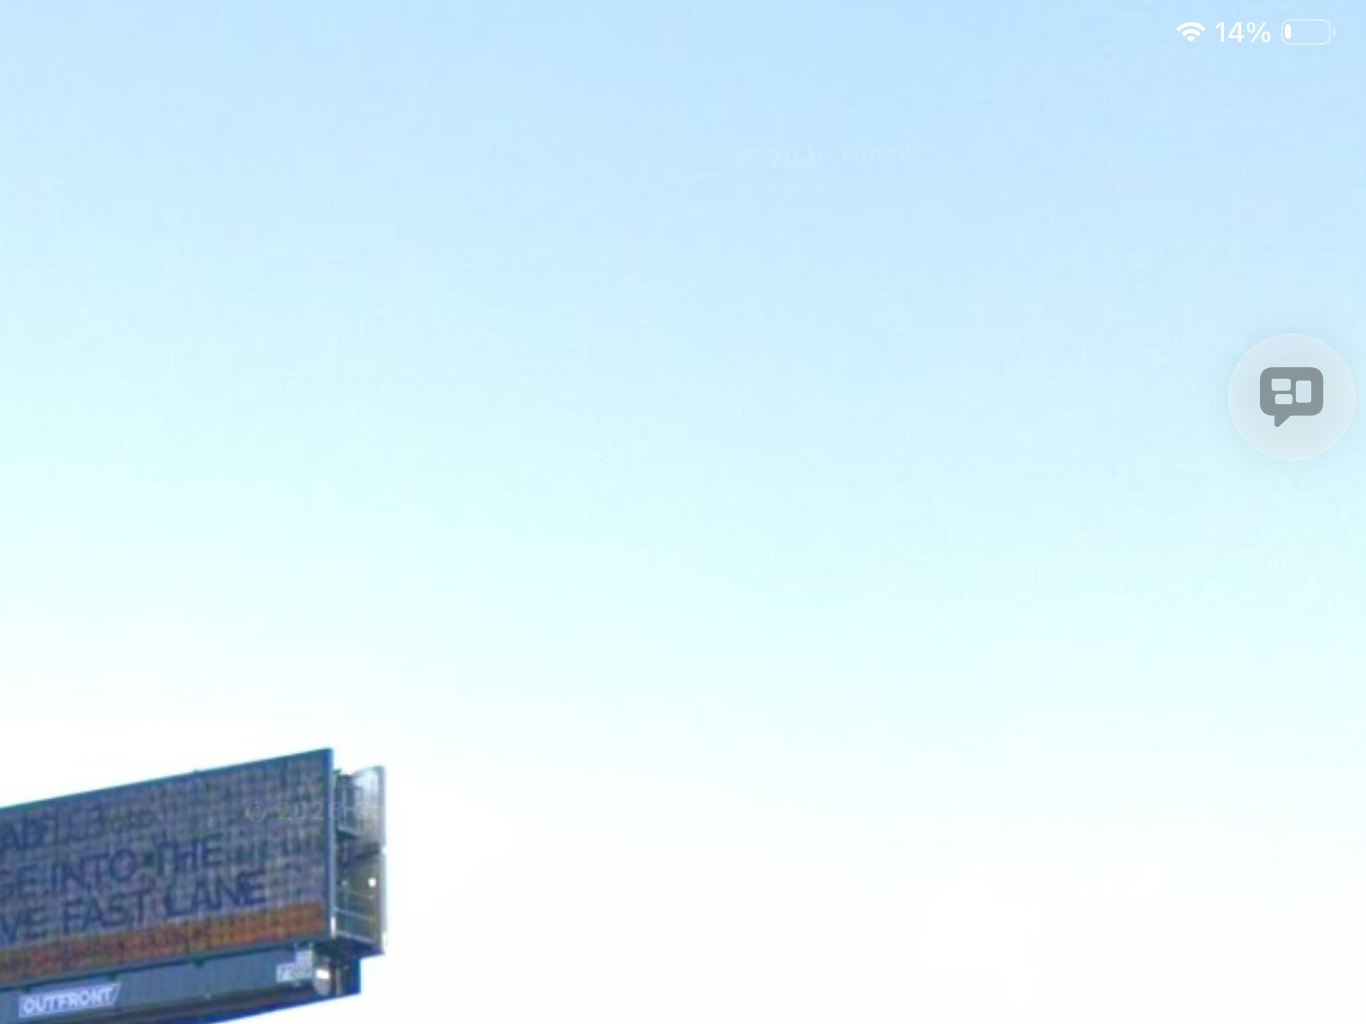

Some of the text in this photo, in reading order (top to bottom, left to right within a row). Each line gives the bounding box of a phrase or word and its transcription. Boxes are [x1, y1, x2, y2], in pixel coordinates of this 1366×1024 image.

[50, 850, 138, 893] INTO
[153, 833, 222, 877] THE
[62, 887, 154, 934] FAST
[162, 869, 268, 918] LANE
[23, 985, 115, 1015] OUTFRONT
